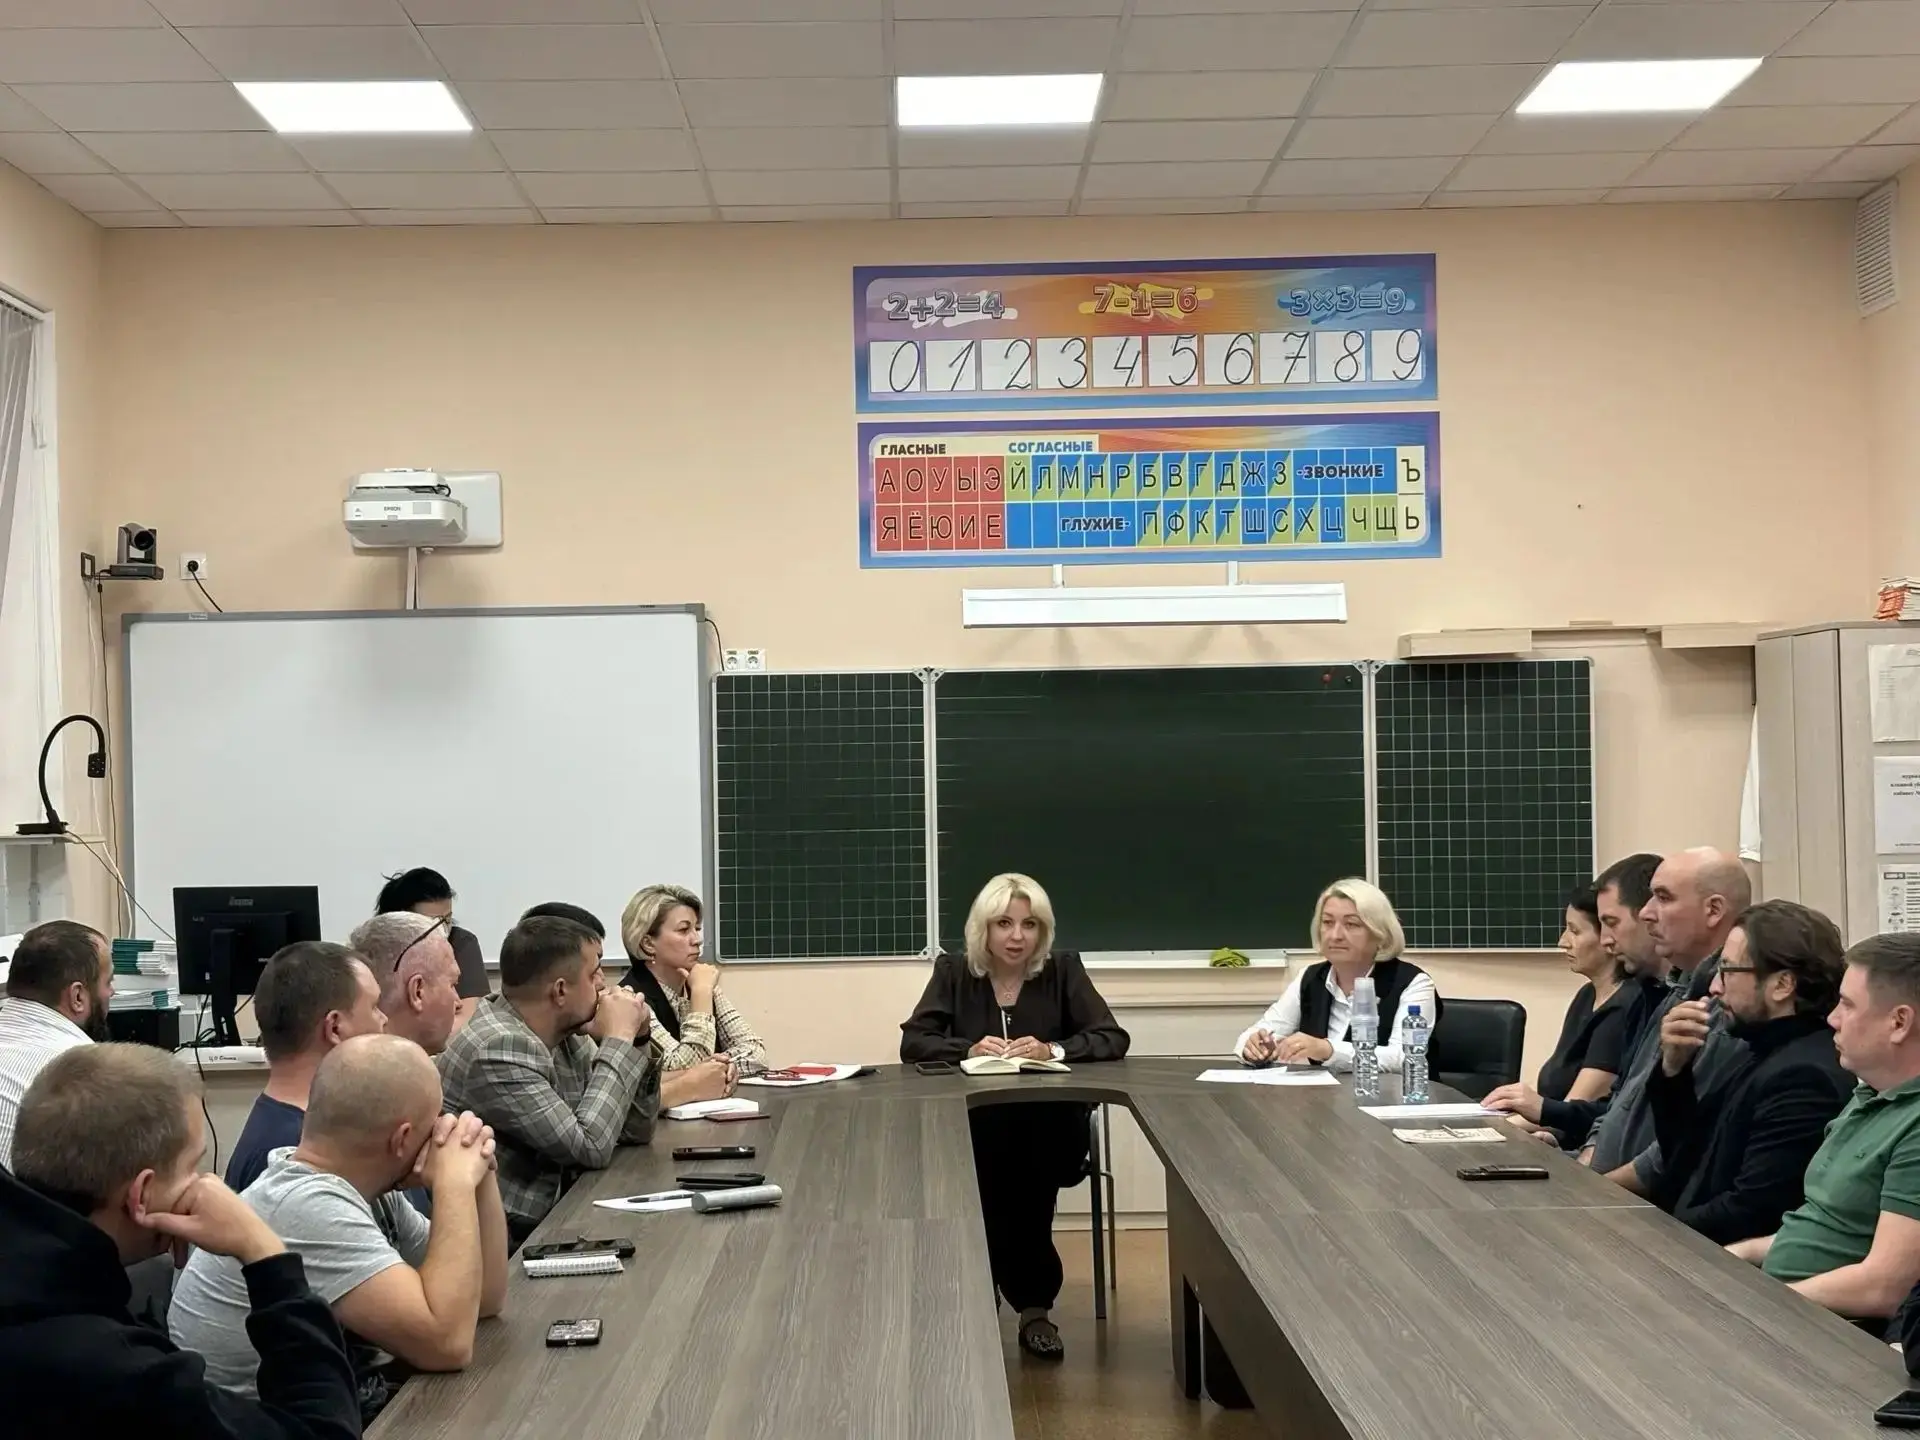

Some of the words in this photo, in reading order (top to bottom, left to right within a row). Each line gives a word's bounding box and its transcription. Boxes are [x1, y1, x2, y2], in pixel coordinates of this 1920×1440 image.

[887, 288, 1005, 322] 2+2=4
[1093, 285, 1199, 316] 7-1=6
[889, 340, 921, 393] 0
[948, 340, 975, 391] 1
[1004, 339, 1032, 390] 2
[1057, 337, 1088, 389] 3
[1113, 337, 1141, 387] 4
[1168, 334, 1198, 385] 5
[1224, 332, 1256, 384] 6
[1282, 331, 1310, 383] 7
[1334, 330, 1365, 382] 8
[1392, 328, 1421, 380] 9
[880, 443, 946, 456] ГЛАСНЫЕ
[1008, 441, 1093, 453] СОГЛАСНЫЕ
